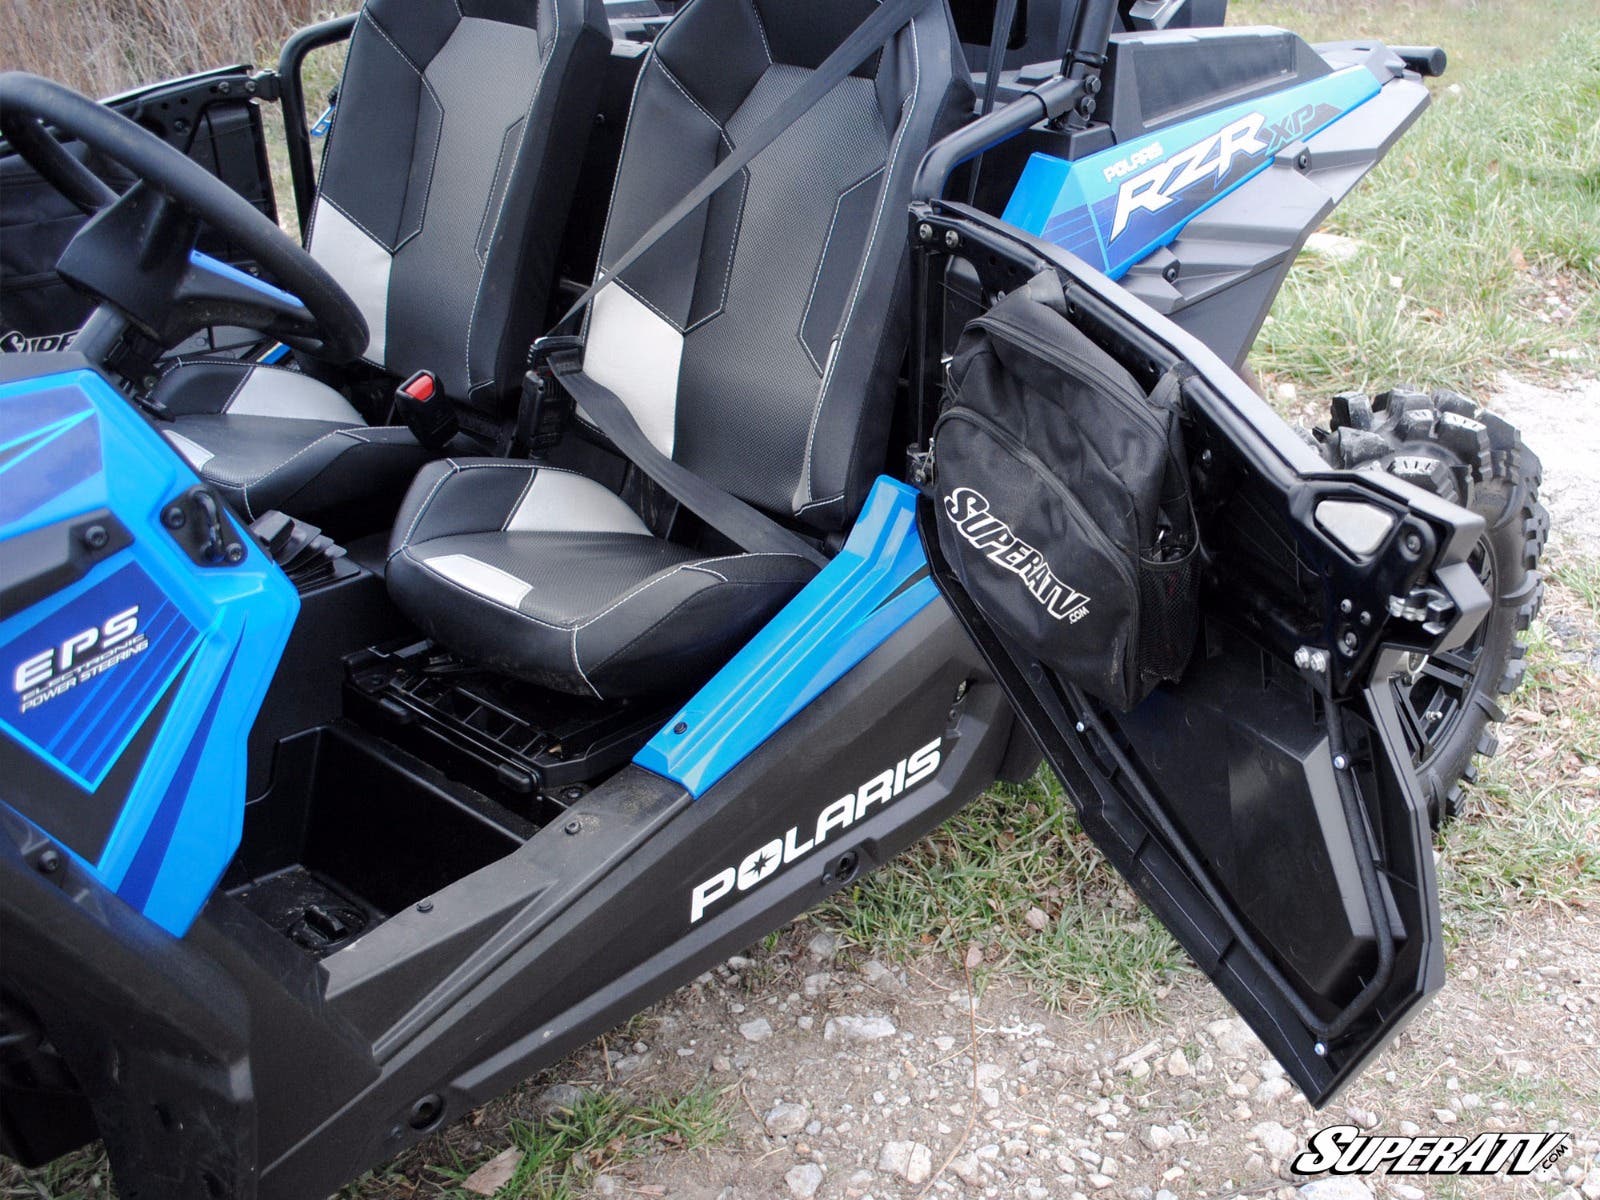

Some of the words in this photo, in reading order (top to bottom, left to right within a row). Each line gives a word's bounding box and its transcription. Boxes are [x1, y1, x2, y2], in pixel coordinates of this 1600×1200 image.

[1103, 141, 1164, 183] POLARIS
[1108, 111, 1269, 244] RZR
[1265, 103, 1317, 157] XP
[15, 605, 139, 693] EPS
[20, 675, 77, 715] POWER
[80, 638, 149, 684] STEERING
[22, 632, 146, 701] ELECTRONIC
[690, 736, 942, 924] POLARIS
